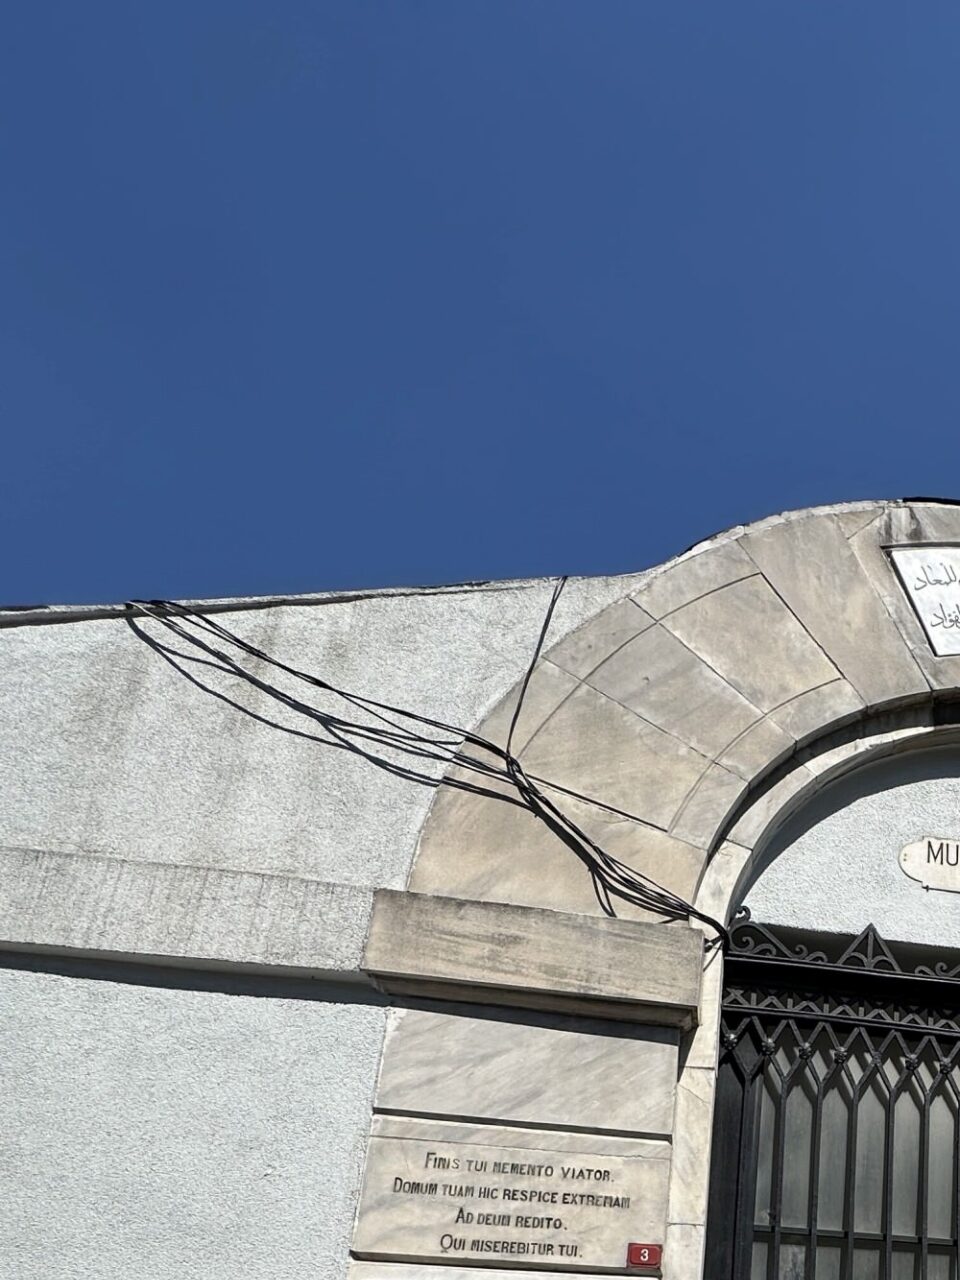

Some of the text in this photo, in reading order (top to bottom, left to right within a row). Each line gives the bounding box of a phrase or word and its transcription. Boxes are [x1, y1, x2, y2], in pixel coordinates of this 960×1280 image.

[466, 1159, 487, 1172] TUI
[493, 1162, 554, 1176] MEMENTO
[560, 1166, 615, 1182] VIATOR.
[442, 1184, 474, 1197] TUAM
[479, 1187, 498, 1199] HIC
[503, 1189, 557, 1203] RESPICE
[562, 1193, 630, 1208] EXTREMAM
[477, 1213, 510, 1226] DEUM
[515, 1215, 567, 1230] REDITO.
[471, 1238, 554, 1256] MISEREBITUR
[558, 1245, 583, 1258] TUI.
[640, 1249, 649, 1261] 3
